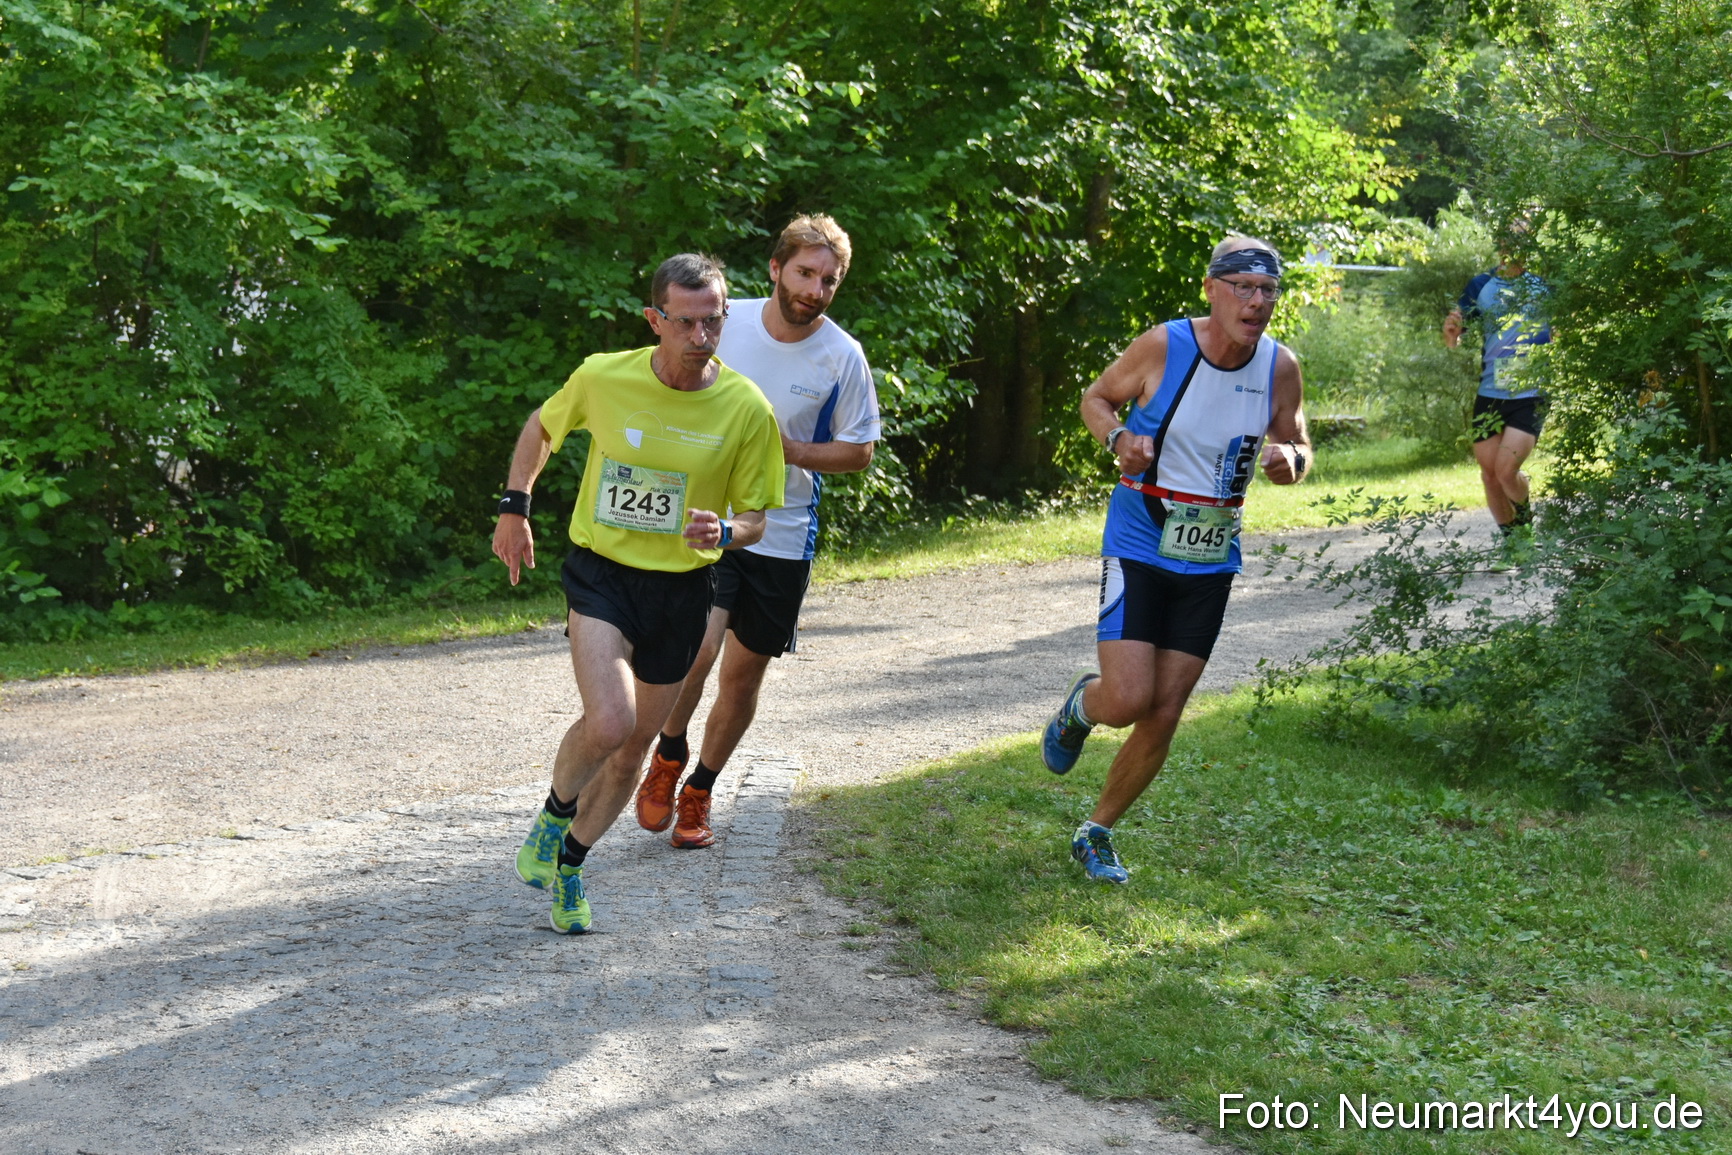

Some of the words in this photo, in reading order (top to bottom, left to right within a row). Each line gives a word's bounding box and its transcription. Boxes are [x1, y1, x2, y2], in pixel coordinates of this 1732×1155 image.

[1229, 434, 1259, 499] HUB
[607, 485, 671, 516] 1243
[608, 509, 638, 520] Jezussek
[640, 514, 666, 523] Damian
[1172, 543, 1187, 551] Hack
[1174, 524, 1226, 547] 1045
